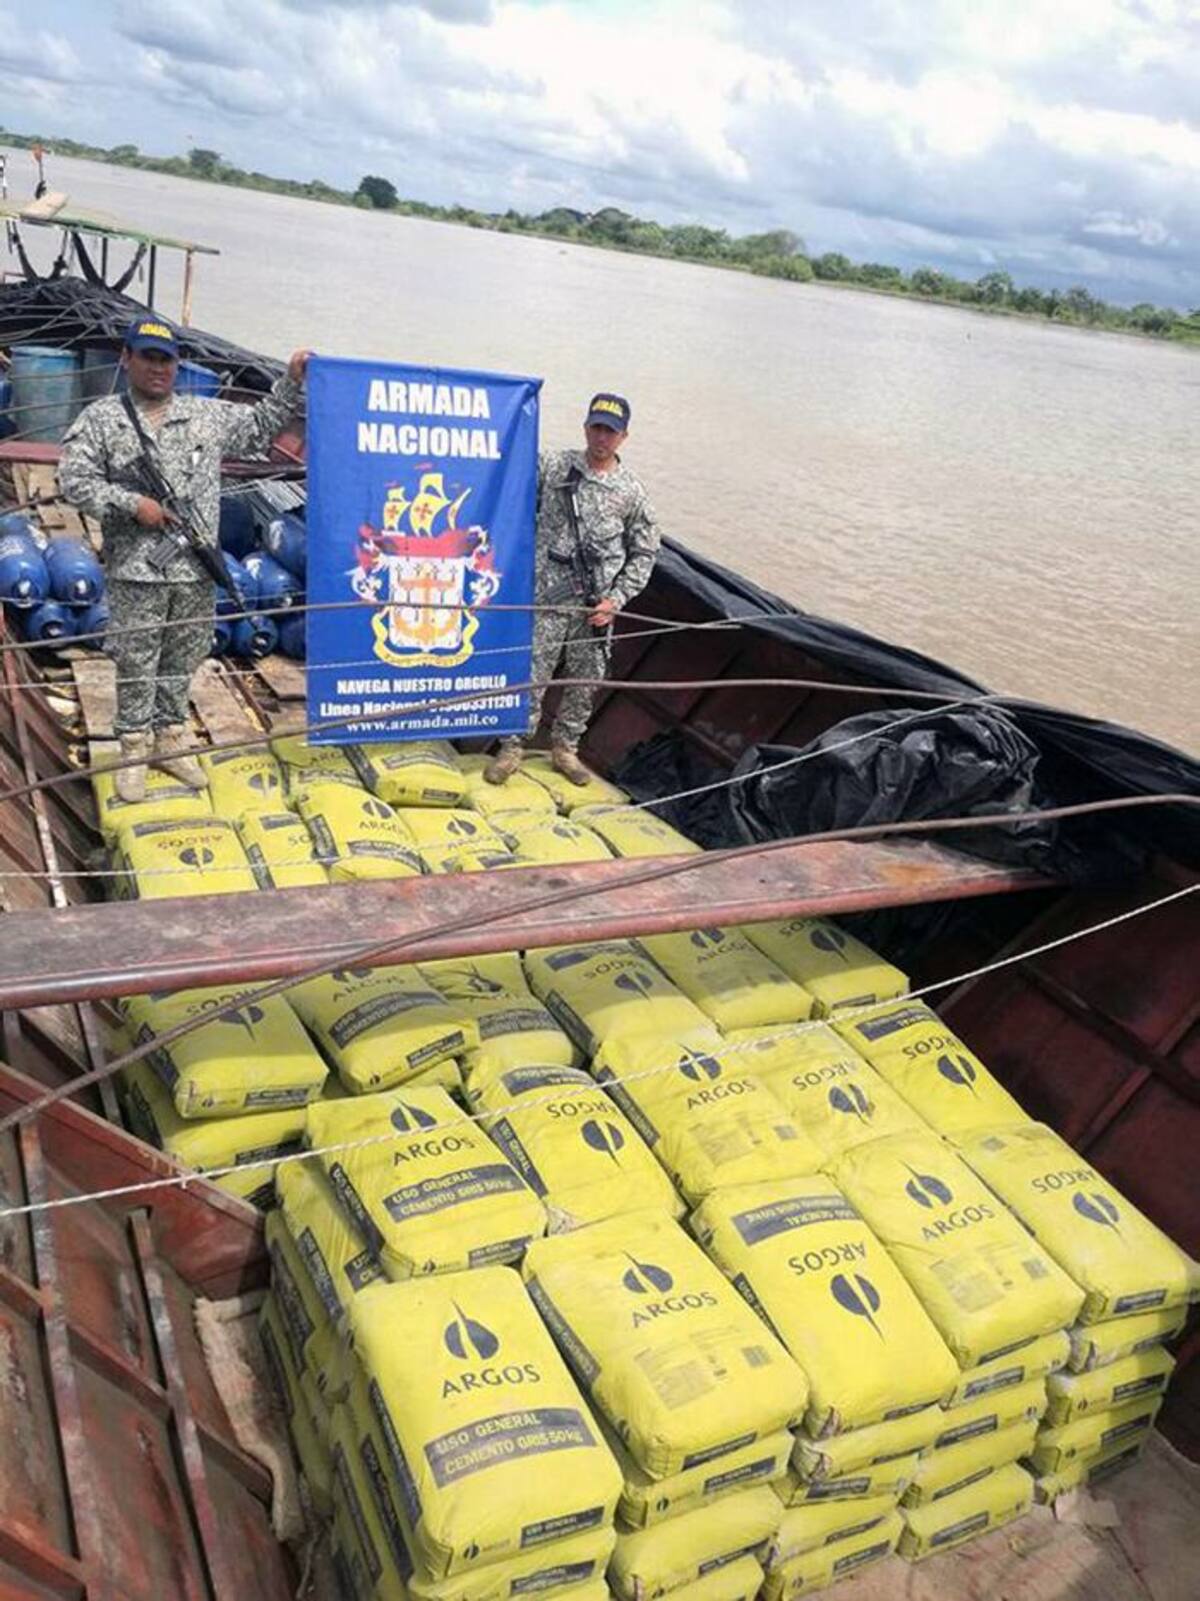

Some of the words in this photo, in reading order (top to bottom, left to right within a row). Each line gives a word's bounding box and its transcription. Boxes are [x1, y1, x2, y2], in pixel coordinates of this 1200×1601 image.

[368, 379, 490, 419] ARMADA
[357, 422, 501, 459] NACIONAL
[337, 679, 391, 694] NAVEGA
[393, 677, 450, 692] NUESTRO
[454, 674, 507, 691] ORGULLO
[320, 702, 361, 717] Linea
[346, 713, 499, 731] www.armada.mil.co
[687, 1078, 755, 1109] ARGOS
[393, 1137, 475, 1166] ARGOS
[392, 1189, 419, 1204] USO
[422, 1170, 476, 1193] GENERAL
[401, 1192, 456, 1215] CEMENTO
[920, 1203, 995, 1240] ARGOS
[788, 1241, 866, 1275] ARGOS
[631, 1291, 718, 1328] ARGOS
[441, 1363, 541, 1398] ARGOS
[436, 1432, 469, 1455] USO
[475, 1412, 541, 1437] GENERAL
[445, 1439, 514, 1475] CEMENTO
